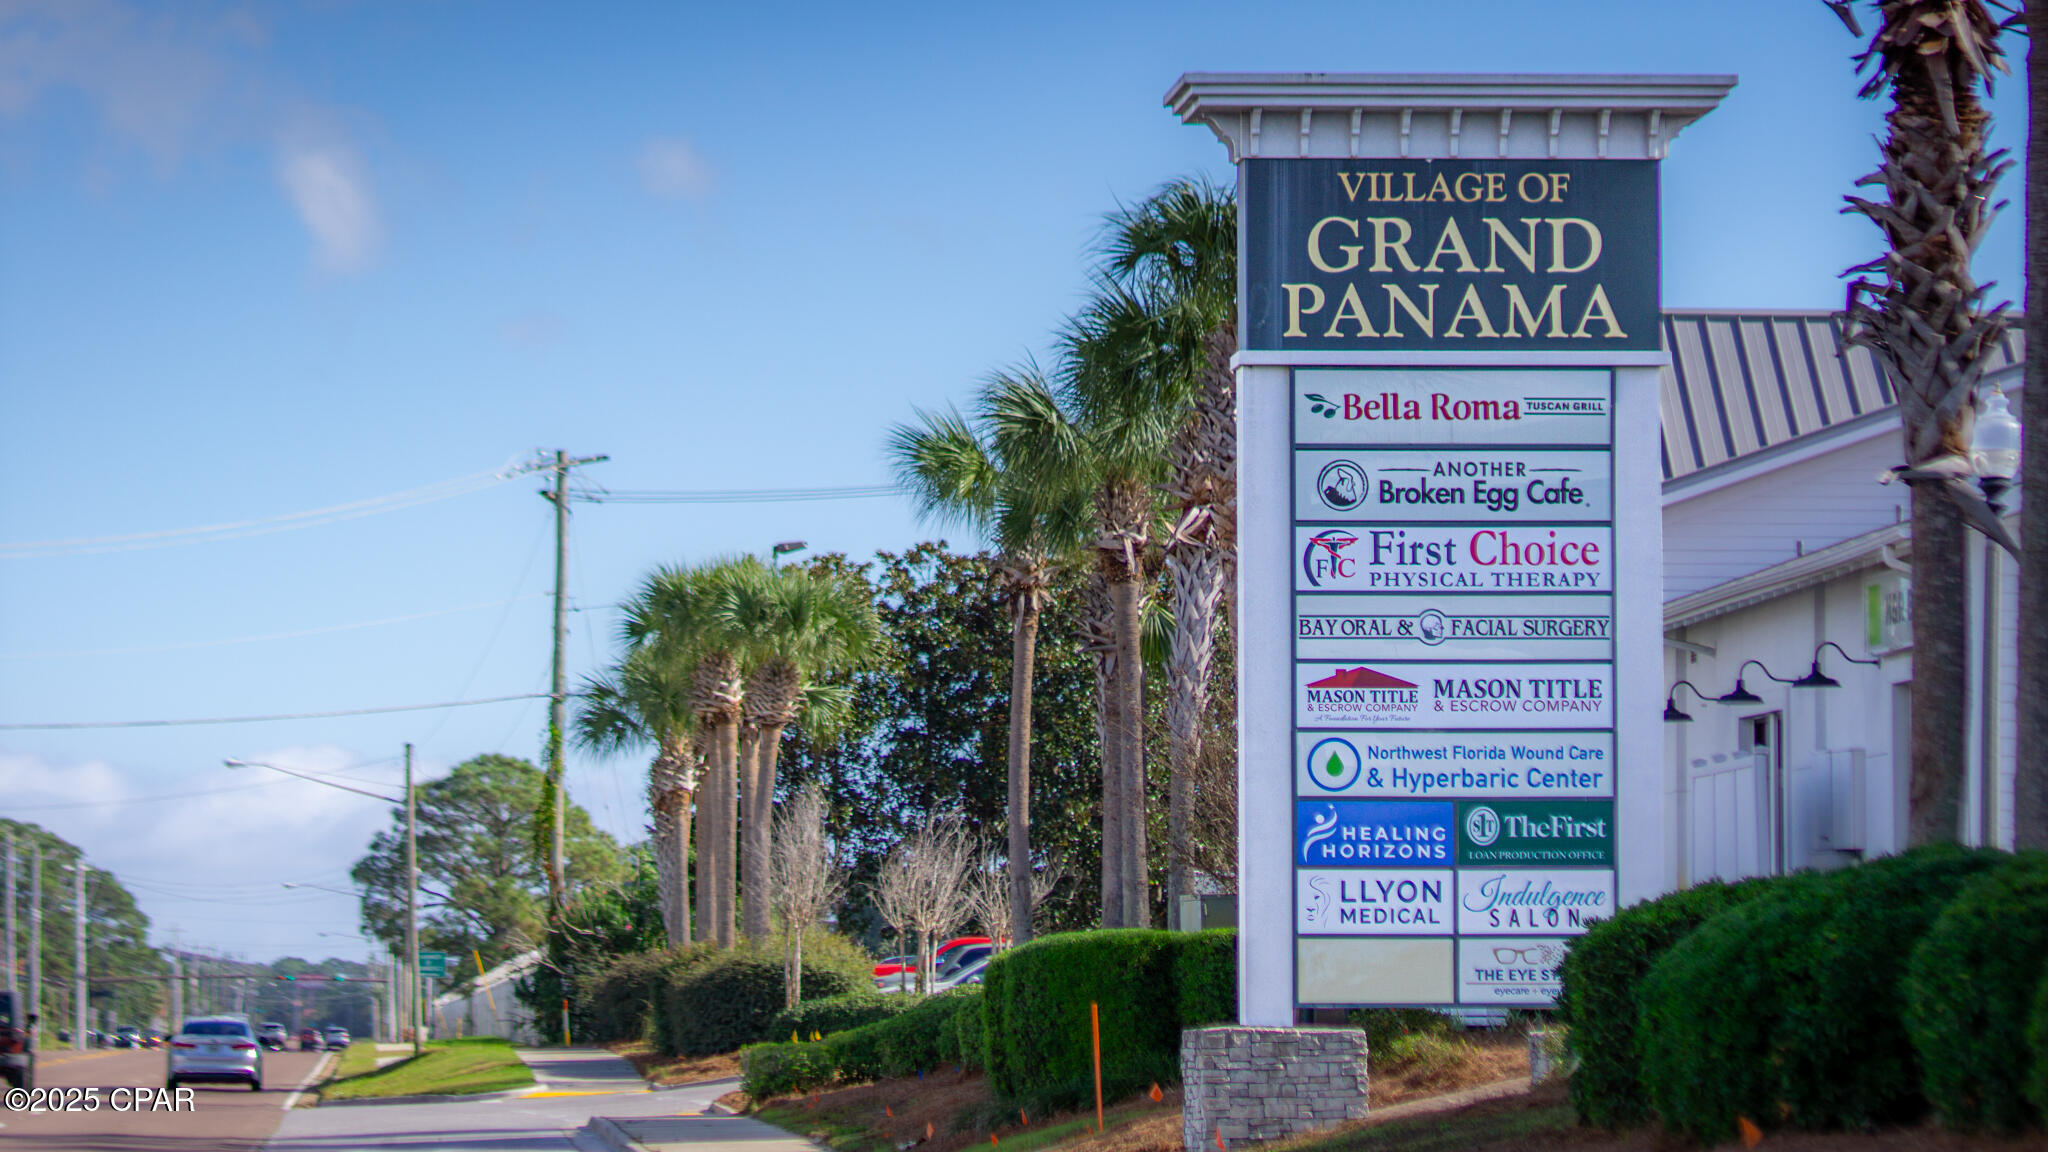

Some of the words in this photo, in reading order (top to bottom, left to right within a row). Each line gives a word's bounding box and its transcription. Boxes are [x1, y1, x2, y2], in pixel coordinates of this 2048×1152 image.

[1337, 172, 1506, 202] VILLAGE
[1518, 173, 1570, 202] OF
[1307, 216, 1603, 274] GRAND
[1281, 282, 1628, 339] PANAMA
[1343, 393, 1422, 420] Bella
[1431, 393, 1522, 420] Roma
[1527, 402, 1570, 410] TUSCAN
[1573, 403, 1604, 411] GRILL
[1433, 462, 1526, 477] ANOTHER
[1379, 477, 1465, 504] Broken
[1473, 480, 1519, 512] Egg
[1369, 530, 1457, 566] First
[1469, 530, 1599, 566] Choice
[1370, 572, 1483, 587] PHYSICAL
[1491, 572, 1600, 587] THERAPY
[1300, 619, 1339, 635] BAY
[1341, 619, 1392, 635] ORAL
[1397, 621, 1414, 635] &
[1452, 619, 1517, 635] FACIAL
[1523, 619, 1609, 636] SURGERY
[1308, 690, 1365, 703] MASON
[1370, 690, 1418, 703] TITLE
[1434, 679, 1521, 699] MASON
[1529, 679, 1602, 699] TITLE
[1434, 700, 1444, 712] &
[1451, 700, 1516, 712] ESCROW
[1523, 700, 1602, 712] COMPANY
[1368, 746, 1447, 760] Northwest
[1453, 746, 1506, 760] Florida
[1512, 746, 1564, 760] Wound
[1569, 746, 1604, 760] Care
[1368, 769, 1383, 788] &
[1393, 768, 1519, 793] Hyperbaric
[1527, 769, 1603, 788] Center
[1343, 827, 1446, 841] HEALING
[1323, 844, 1446, 859] HORIZONS
[1469, 851, 1500, 859] LOAN
[1500, 851, 1566, 859] PRODUCTION
[1569, 851, 1605, 859] OFFICE
[1340, 880, 1441, 903] LLYON
[1464, 874, 1606, 918] Indulgence
[1340, 909, 1440, 924] MEDICAL
[1489, 909, 1580, 927] SALON
[1475, 969, 1504, 981] THE
[1509, 969, 1536, 981] EYE
[1494, 988, 1530, 996] eyecare
